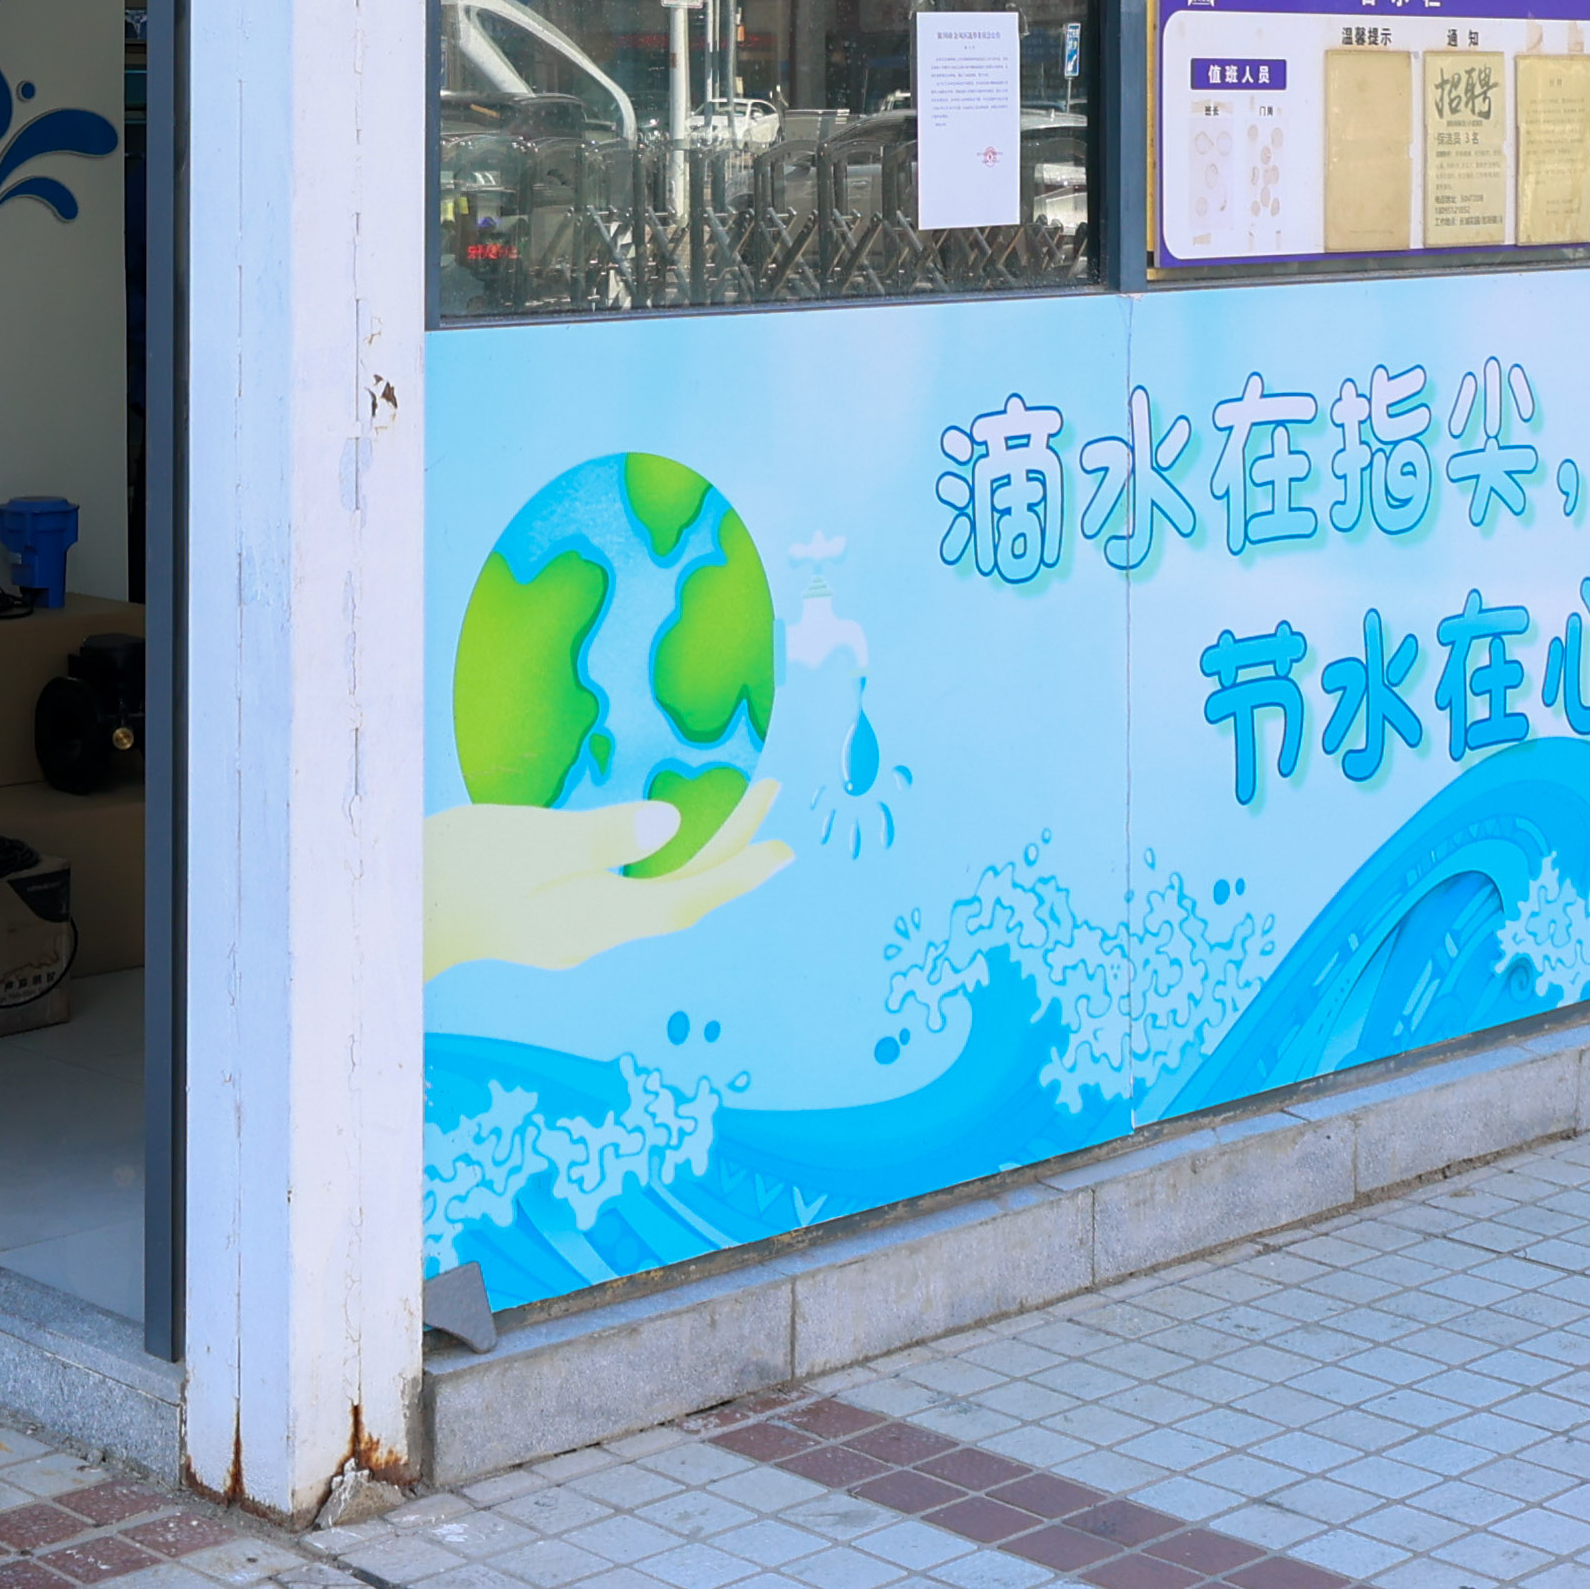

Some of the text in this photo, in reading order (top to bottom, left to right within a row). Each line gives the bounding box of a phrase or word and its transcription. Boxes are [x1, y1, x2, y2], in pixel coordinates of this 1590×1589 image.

[1338, 26, 1479, 51] 温馨提示 通知
[1205, 62, 1273, 87] 值班人员
[1434, 63, 1499, 121] 招聘
[936, 356, 1579, 584] 滴水在指尖，
